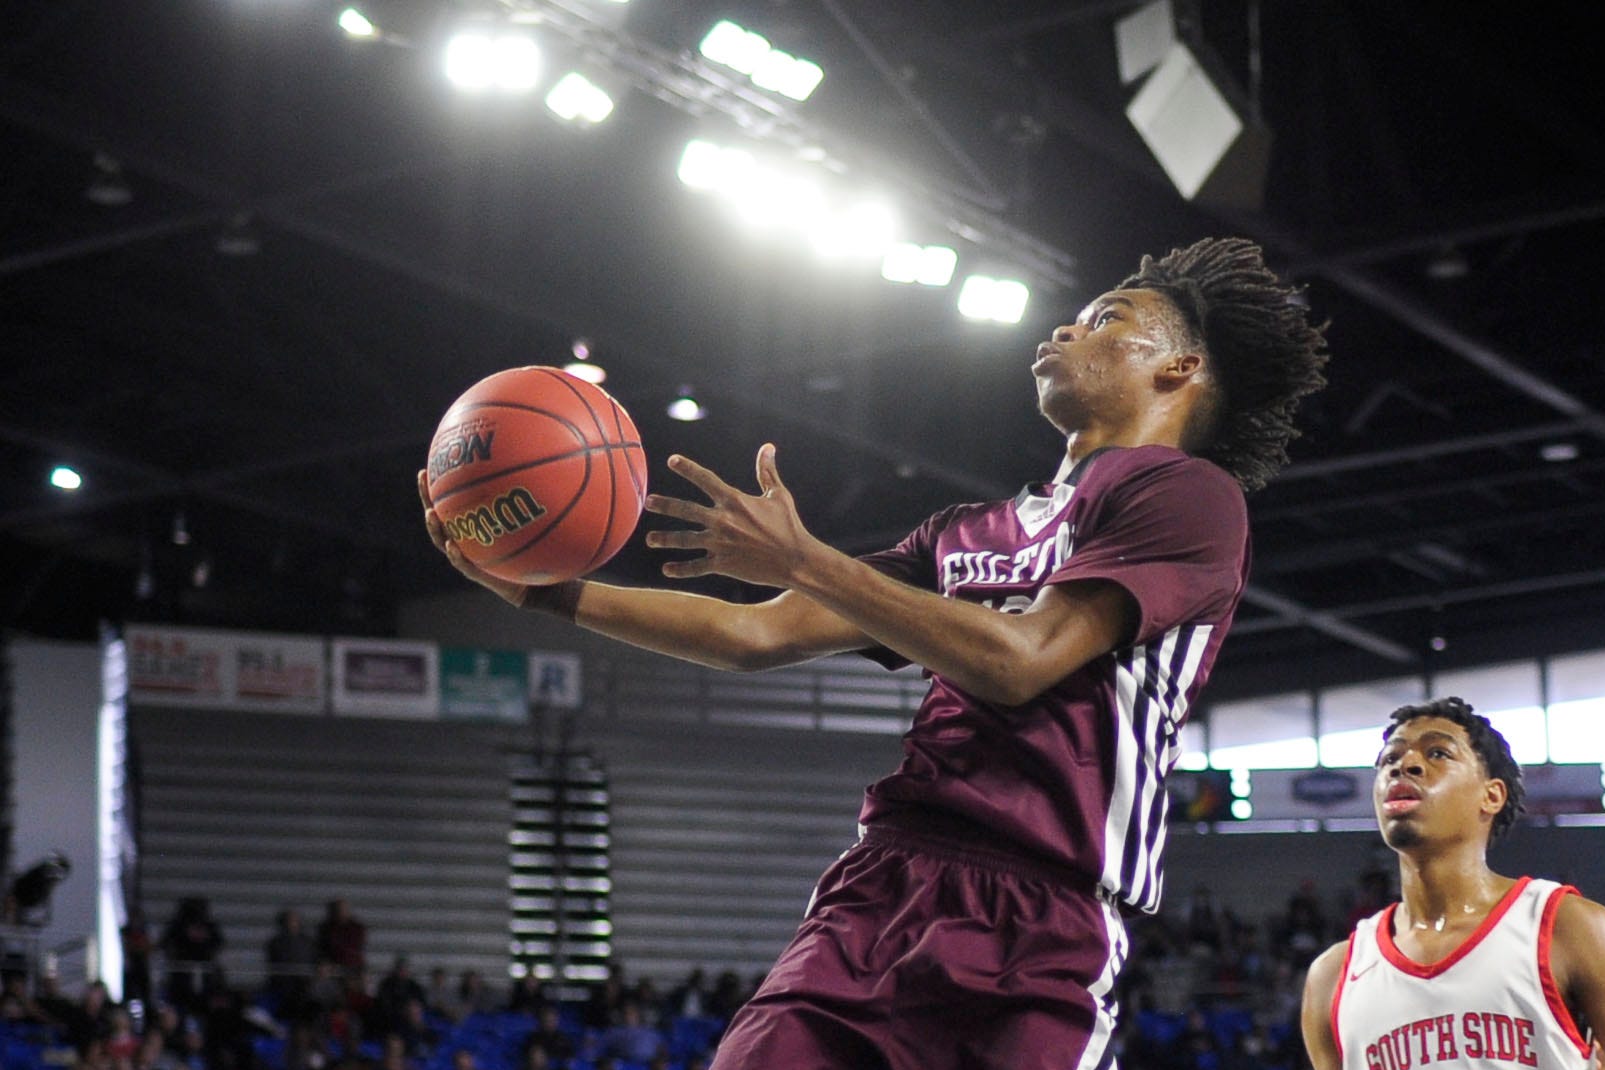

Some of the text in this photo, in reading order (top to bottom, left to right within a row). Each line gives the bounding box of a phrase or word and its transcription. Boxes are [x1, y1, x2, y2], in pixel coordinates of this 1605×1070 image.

[446, 486, 546, 546] Wilso
[942, 521, 1075, 598] FULTO
[1463, 1012, 1538, 1067] SIDE
